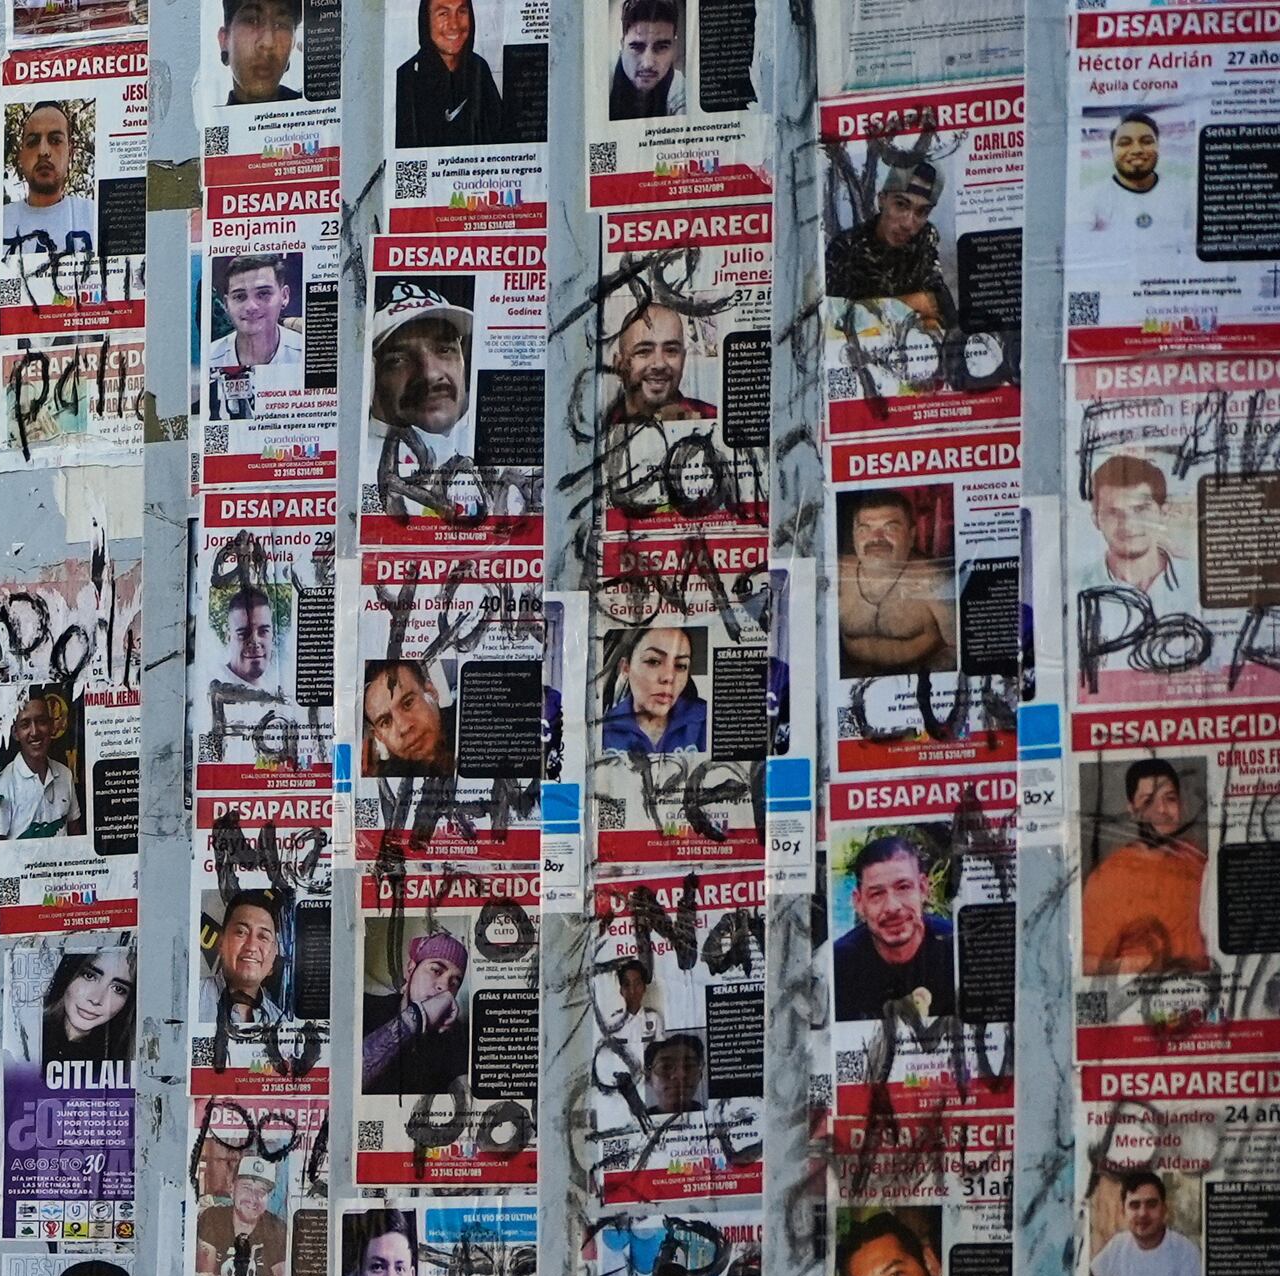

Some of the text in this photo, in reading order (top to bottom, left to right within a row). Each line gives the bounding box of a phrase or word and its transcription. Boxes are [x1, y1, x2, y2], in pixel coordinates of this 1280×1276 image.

[1078, 50, 1213, 72] Héctor Adrián
[1227, 52, 1245, 67] 27
[1132, 78, 1178, 91] Corona
[438, 156, 478, 166] ¡ayúdanos
[487, 153, 536, 163] encontrarlo!
[443, 168, 470, 177] familia
[472, 168, 499, 178] espera
[512, 167, 543, 176] regreso
[453, 178, 522, 191] Guadalajara
[212, 218, 296, 241] Benjamin
[321, 220, 339, 236] 23
[208, 241, 306, 257] Jauregui Castañeda
[721, 249, 764, 268] Julio
[309, 284, 331, 293] SEÑAS
[504, 273, 545, 291] FELIPE
[314, 531, 332, 546] 29
[1091, 713, 1280, 745] DESAPARECID
[24, 861, 57, 870] ¡ayúdanos
[64, 858, 106, 866] encontrarlos!
[29, 871, 52, 879] familia
[54, 870, 75, 879] espera
[85, 869, 109, 878] regreso
[45, 882, 96, 892] Guadalajara
[1224, 1105, 1249, 1122] 24
[11, 1152, 105, 1174] AGOSTO 30
